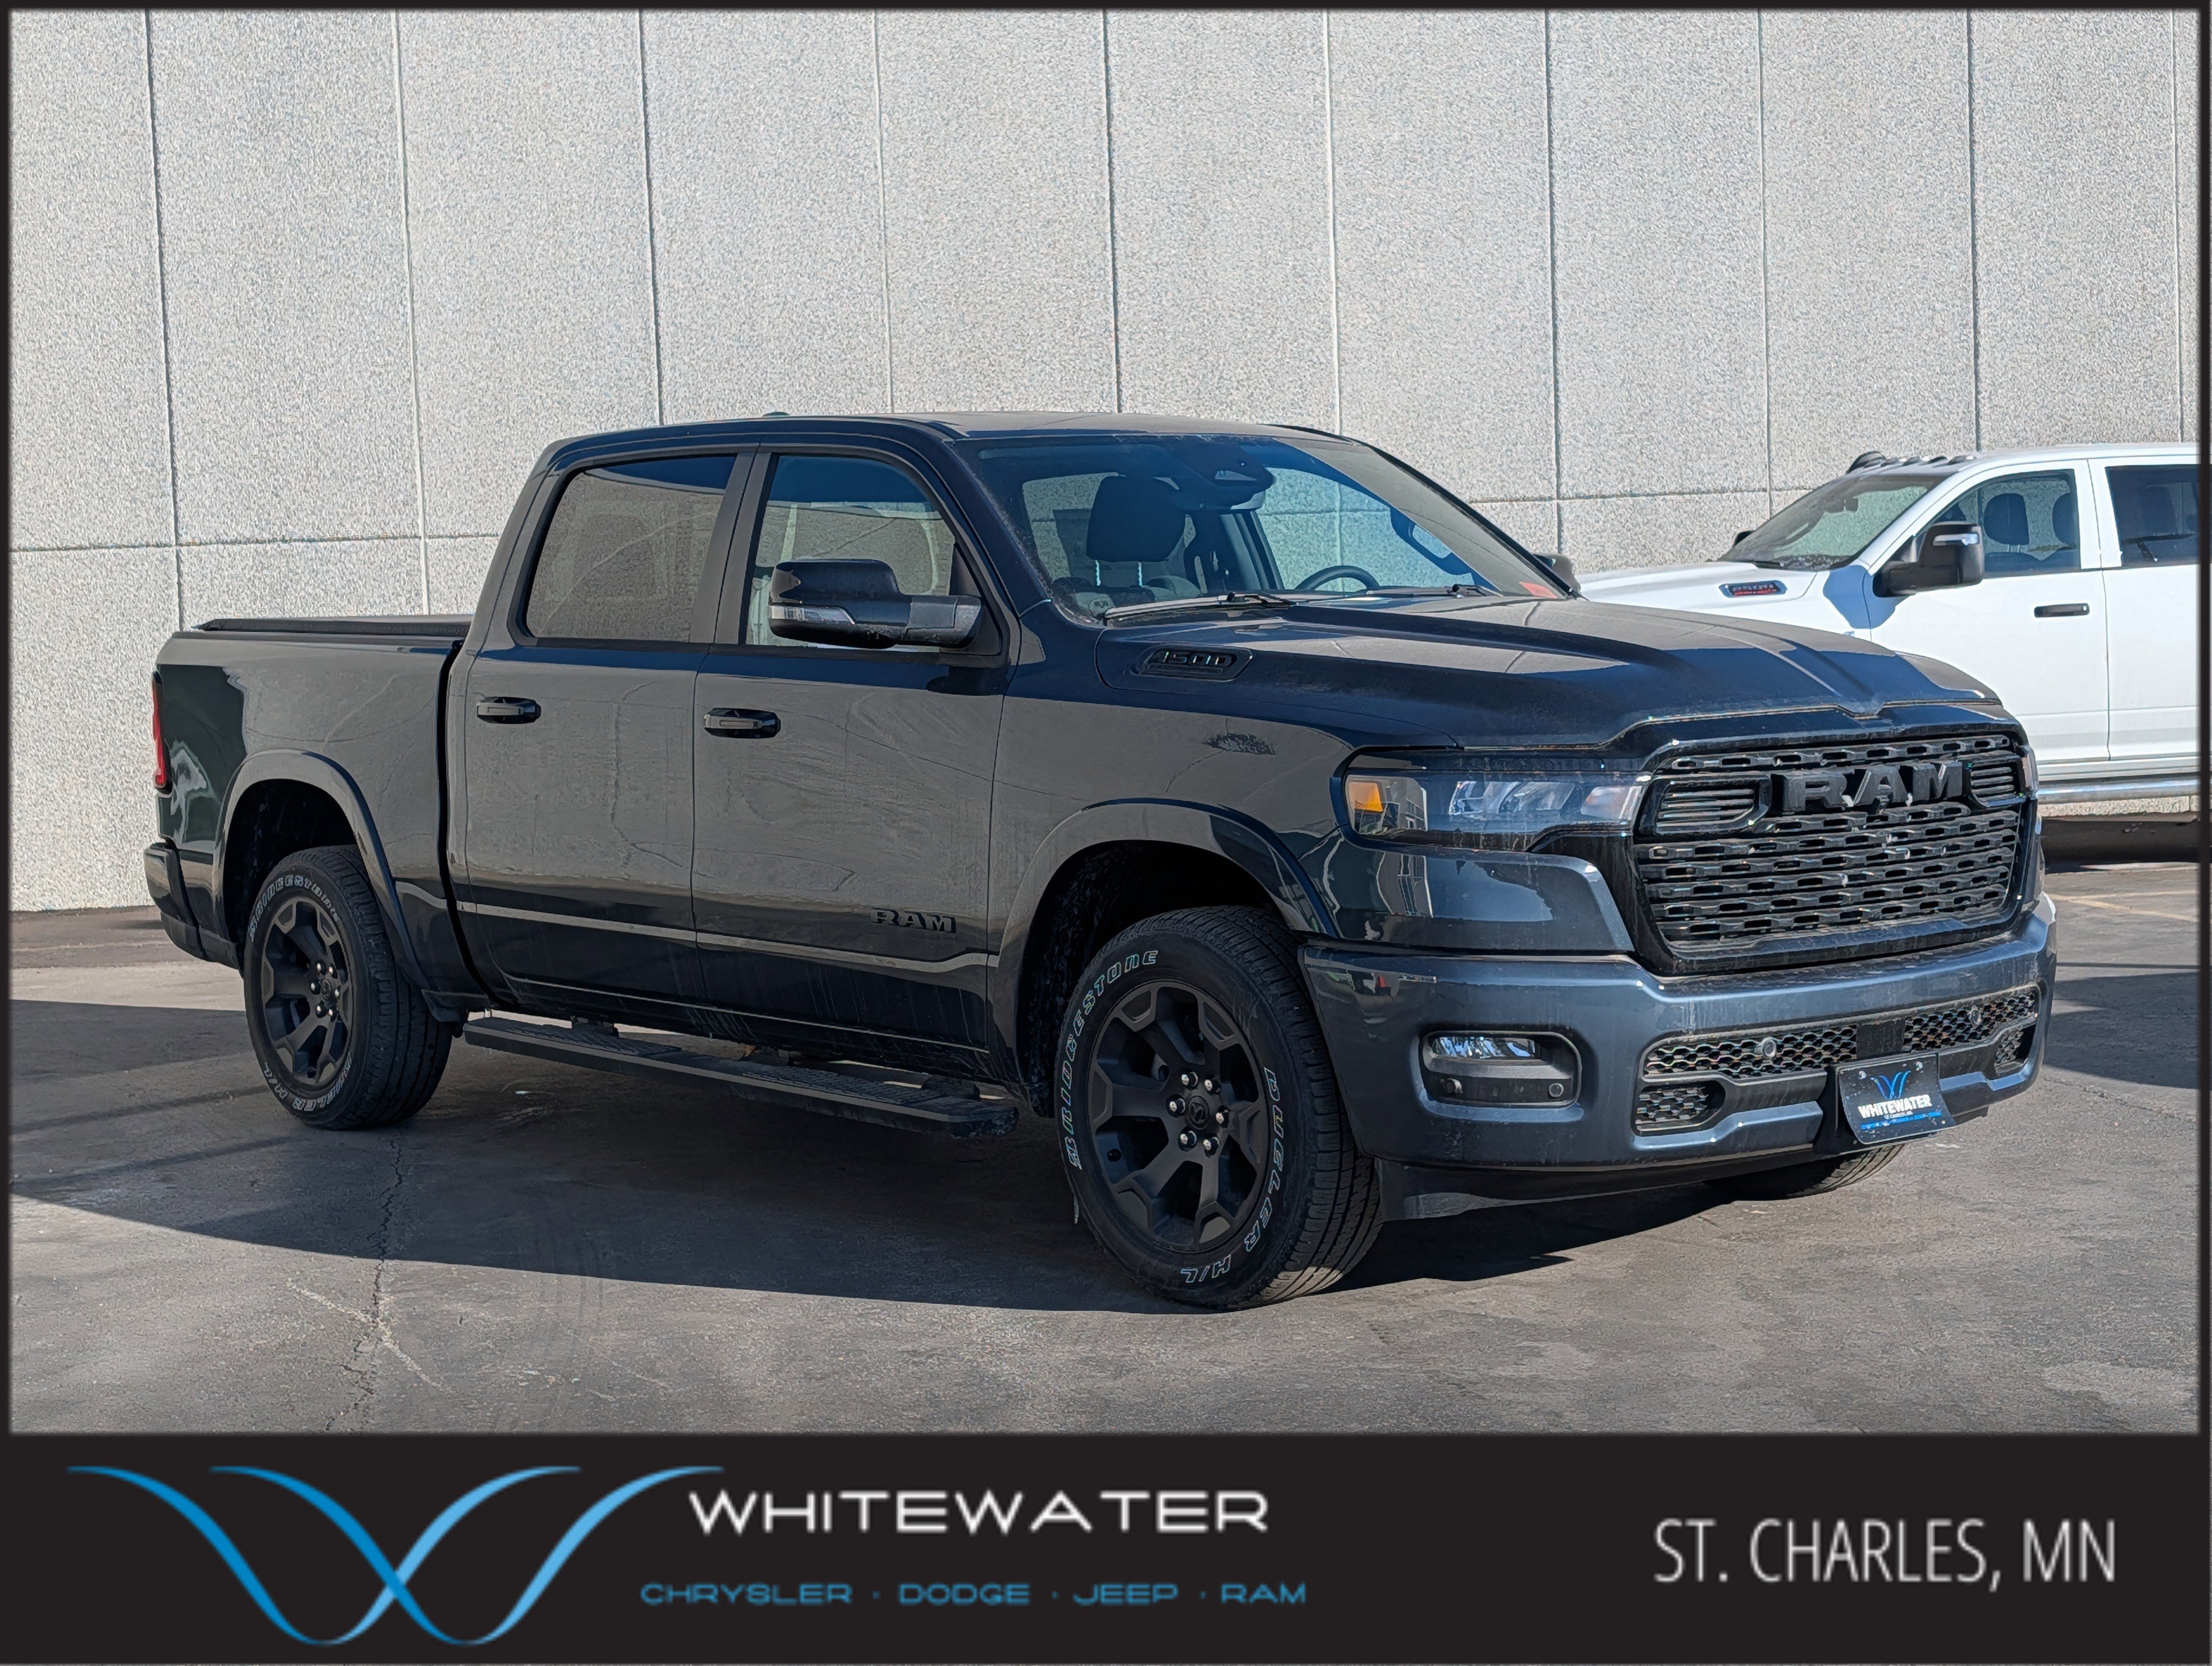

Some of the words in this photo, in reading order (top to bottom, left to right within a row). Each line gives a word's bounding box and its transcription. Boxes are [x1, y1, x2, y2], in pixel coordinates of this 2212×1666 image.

[1782, 760, 1963, 813] RAM
[871, 907, 956, 933] RAM
[1059, 950, 1159, 1170] BRIDGESTONE
[1857, 1094, 1933, 1119] WHITEWATER
[1244, 1067, 1285, 1252] DUELER
[1180, 1254, 1232, 1284] H/L
